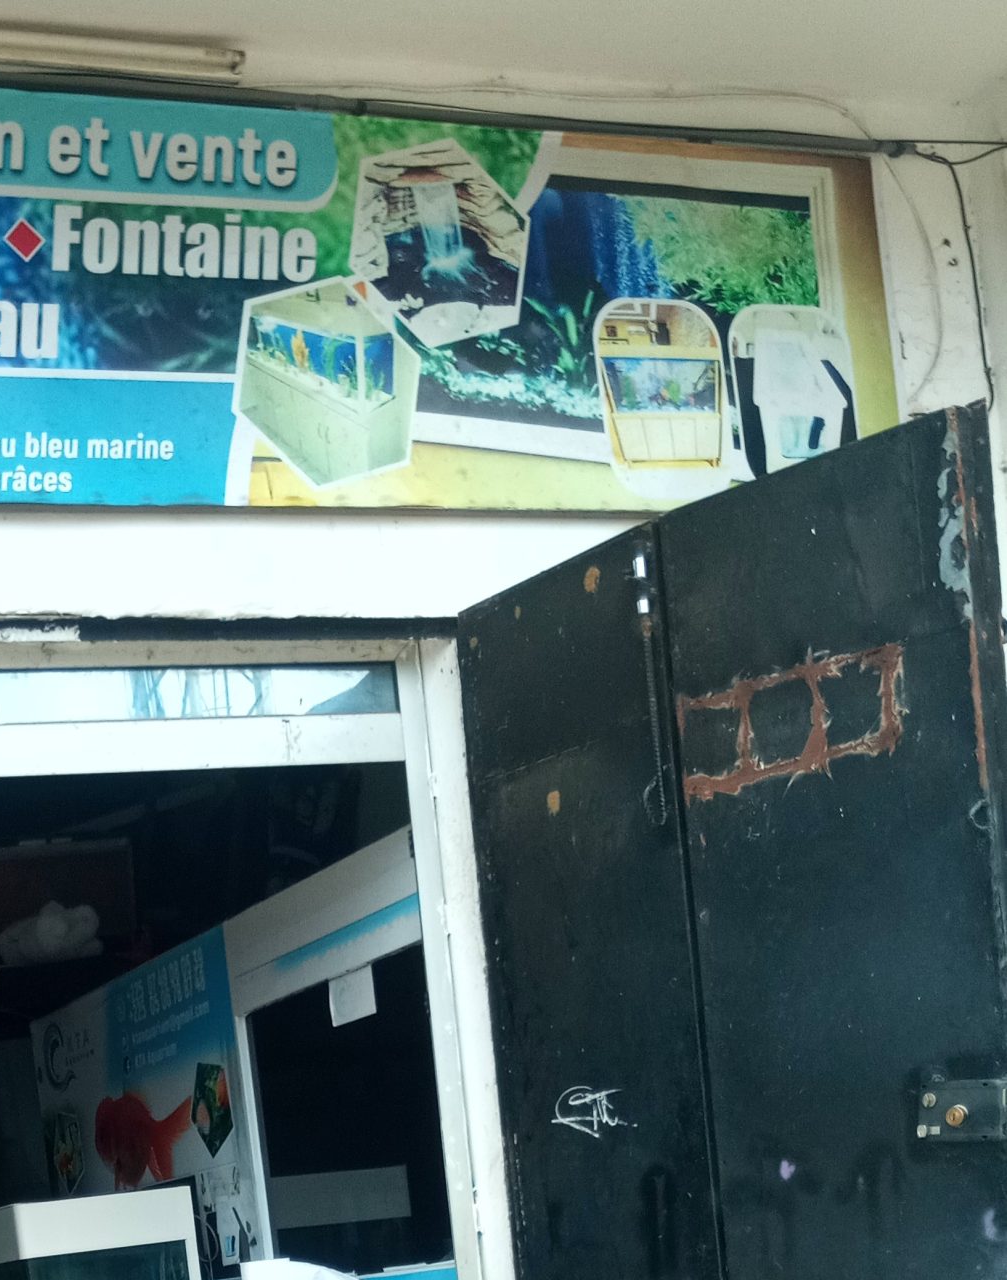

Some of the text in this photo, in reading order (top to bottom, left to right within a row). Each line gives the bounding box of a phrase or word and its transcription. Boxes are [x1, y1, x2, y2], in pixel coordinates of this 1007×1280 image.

[47, 116, 111, 180] et
[129, 129, 298, 188] vente
[50, 204, 317, 282] Fontaine
[24, 433, 80, 459] bleu
[87, 434, 175, 461] marine
